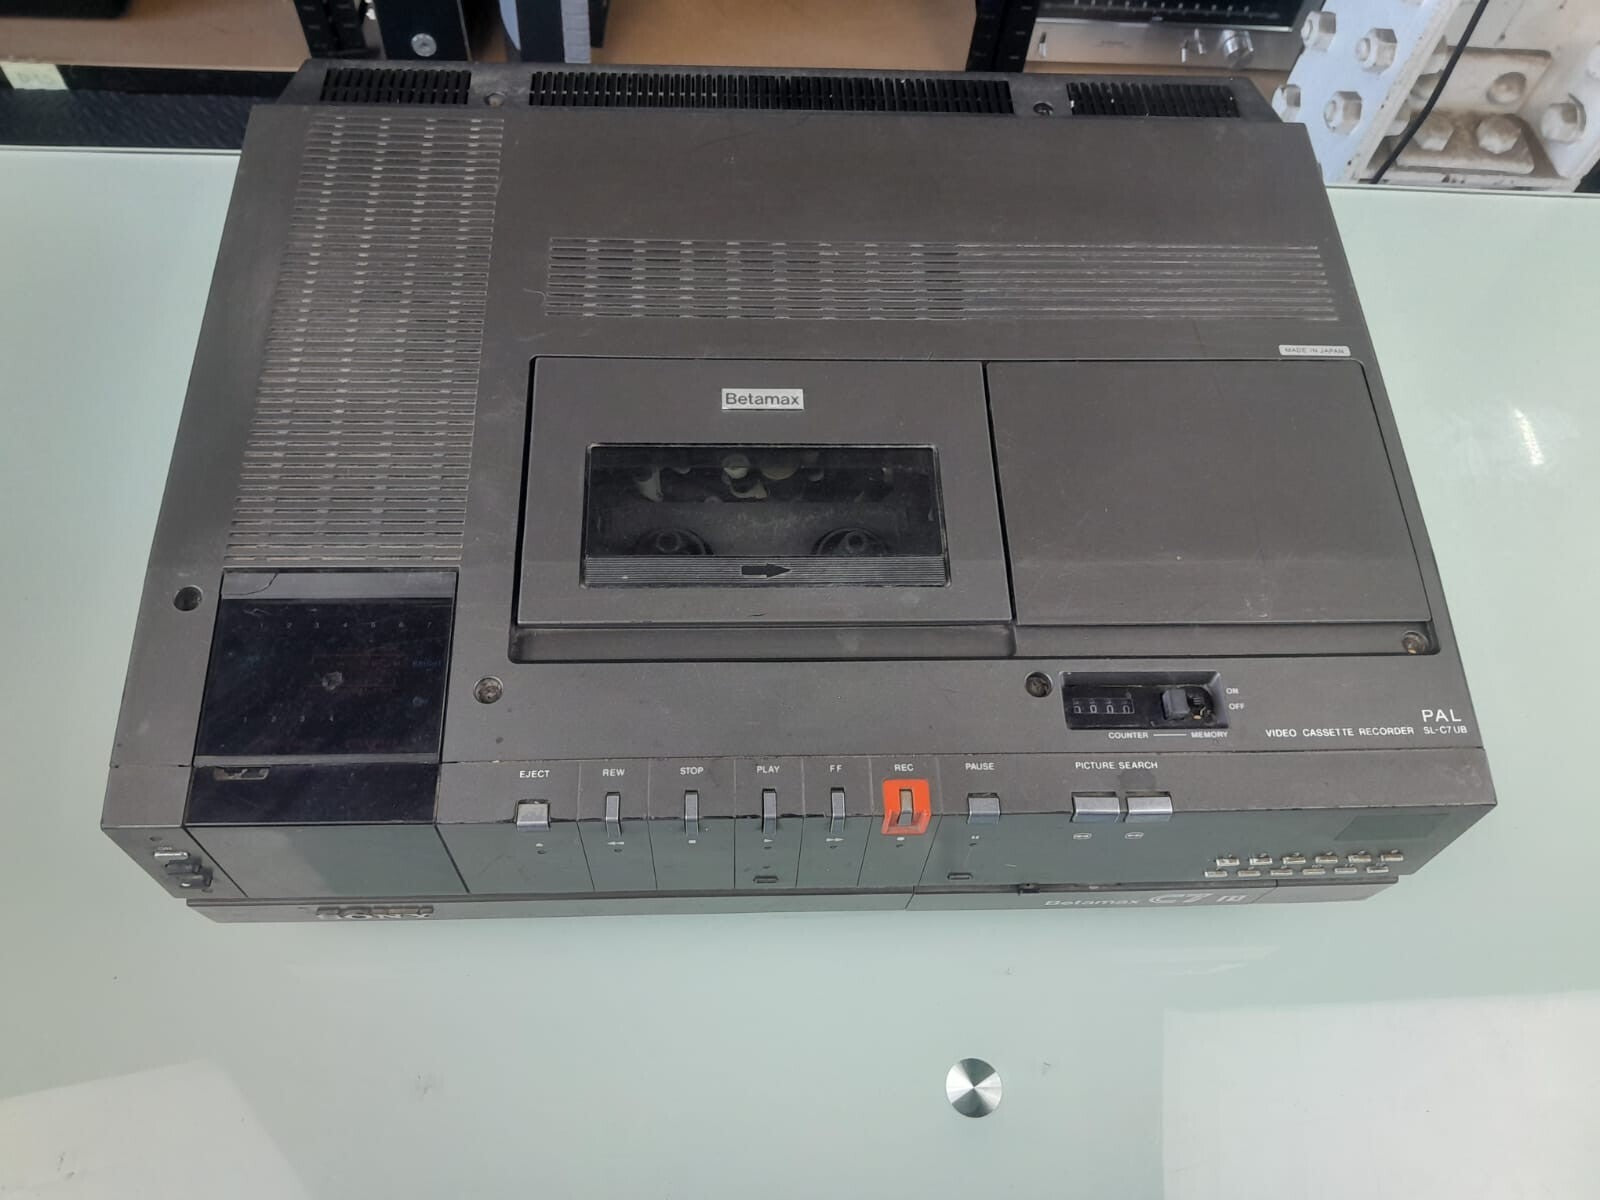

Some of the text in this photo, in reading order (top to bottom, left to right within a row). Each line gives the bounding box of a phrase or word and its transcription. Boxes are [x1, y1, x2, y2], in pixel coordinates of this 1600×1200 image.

[725, 392, 800, 406] Betamax
[1225, 687, 1239, 695] ON
[1421, 708, 1462, 723] PAL
[1108, 730, 1229, 740] COUNTER MEMORY
[1265, 728, 1297, 738] VIDEO
[1302, 727, 1355, 737] CASSETTE
[1359, 726, 1415, 736] RECORDER
[756, 765, 780, 774] PLAY
[829, 764, 843, 773] FF
[894, 763, 914, 772] REC
[965, 762, 995, 771] PAUSE
[1074, 760, 1158, 770] PICTURE SEARCH
[519, 769, 550, 779] EJECT
[602, 768, 625, 777] REW
[679, 766, 704, 776] STOP
